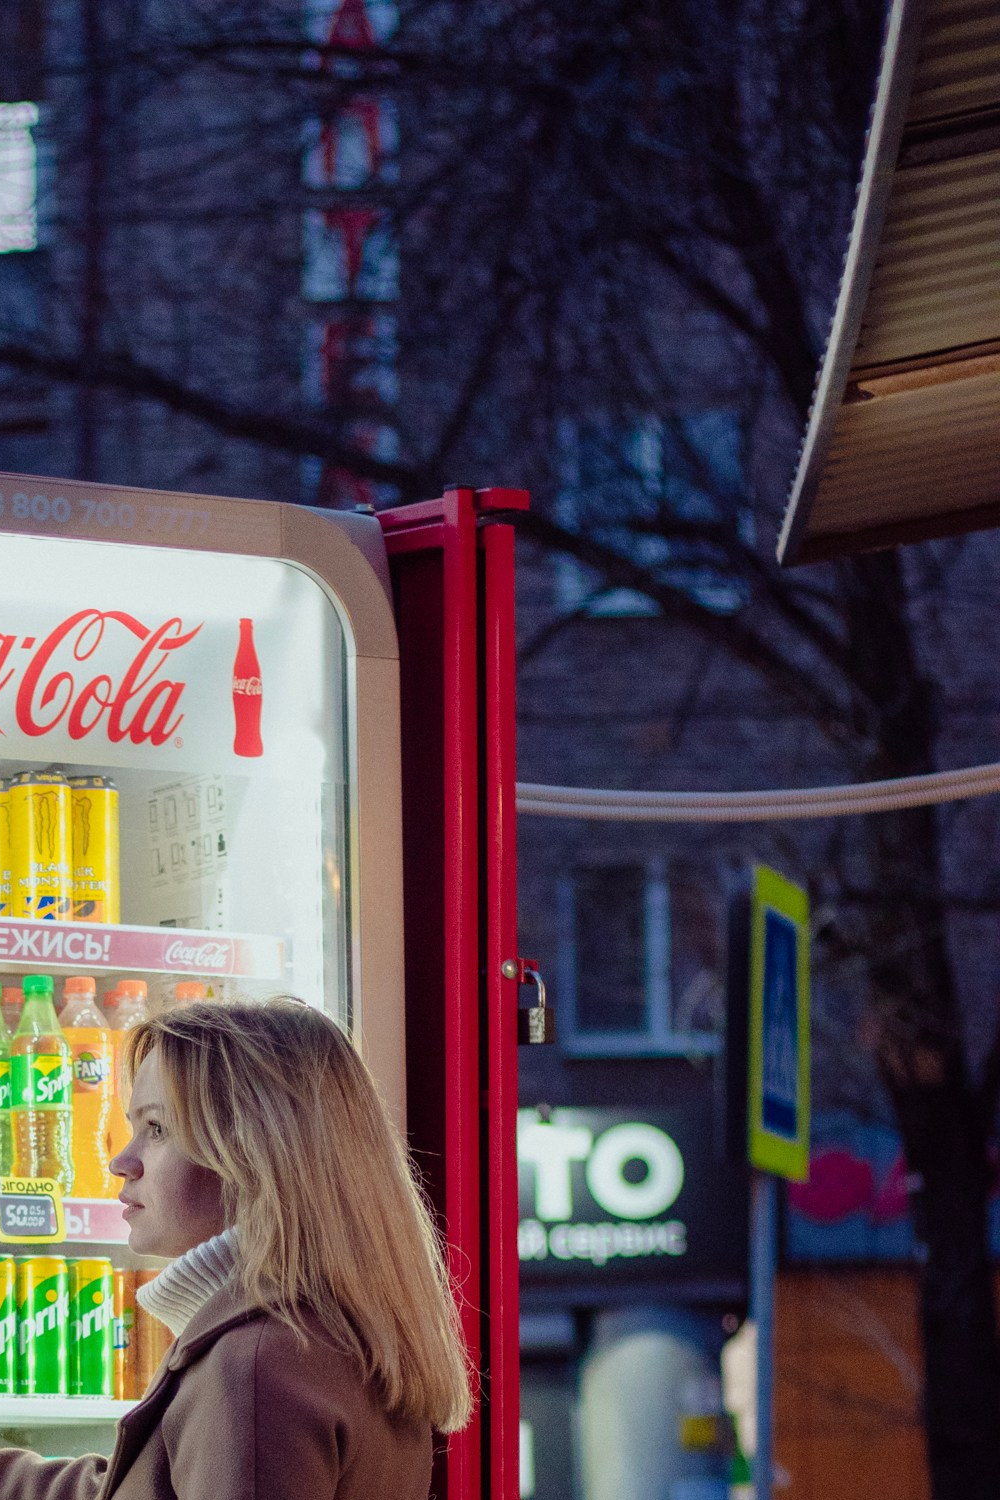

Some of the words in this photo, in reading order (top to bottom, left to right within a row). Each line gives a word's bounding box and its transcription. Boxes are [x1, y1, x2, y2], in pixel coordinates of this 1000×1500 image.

[12, 492, 71, 523] 800
[78, 499, 136, 529] 700
[165, 940, 232, 968] Coca-Cola
